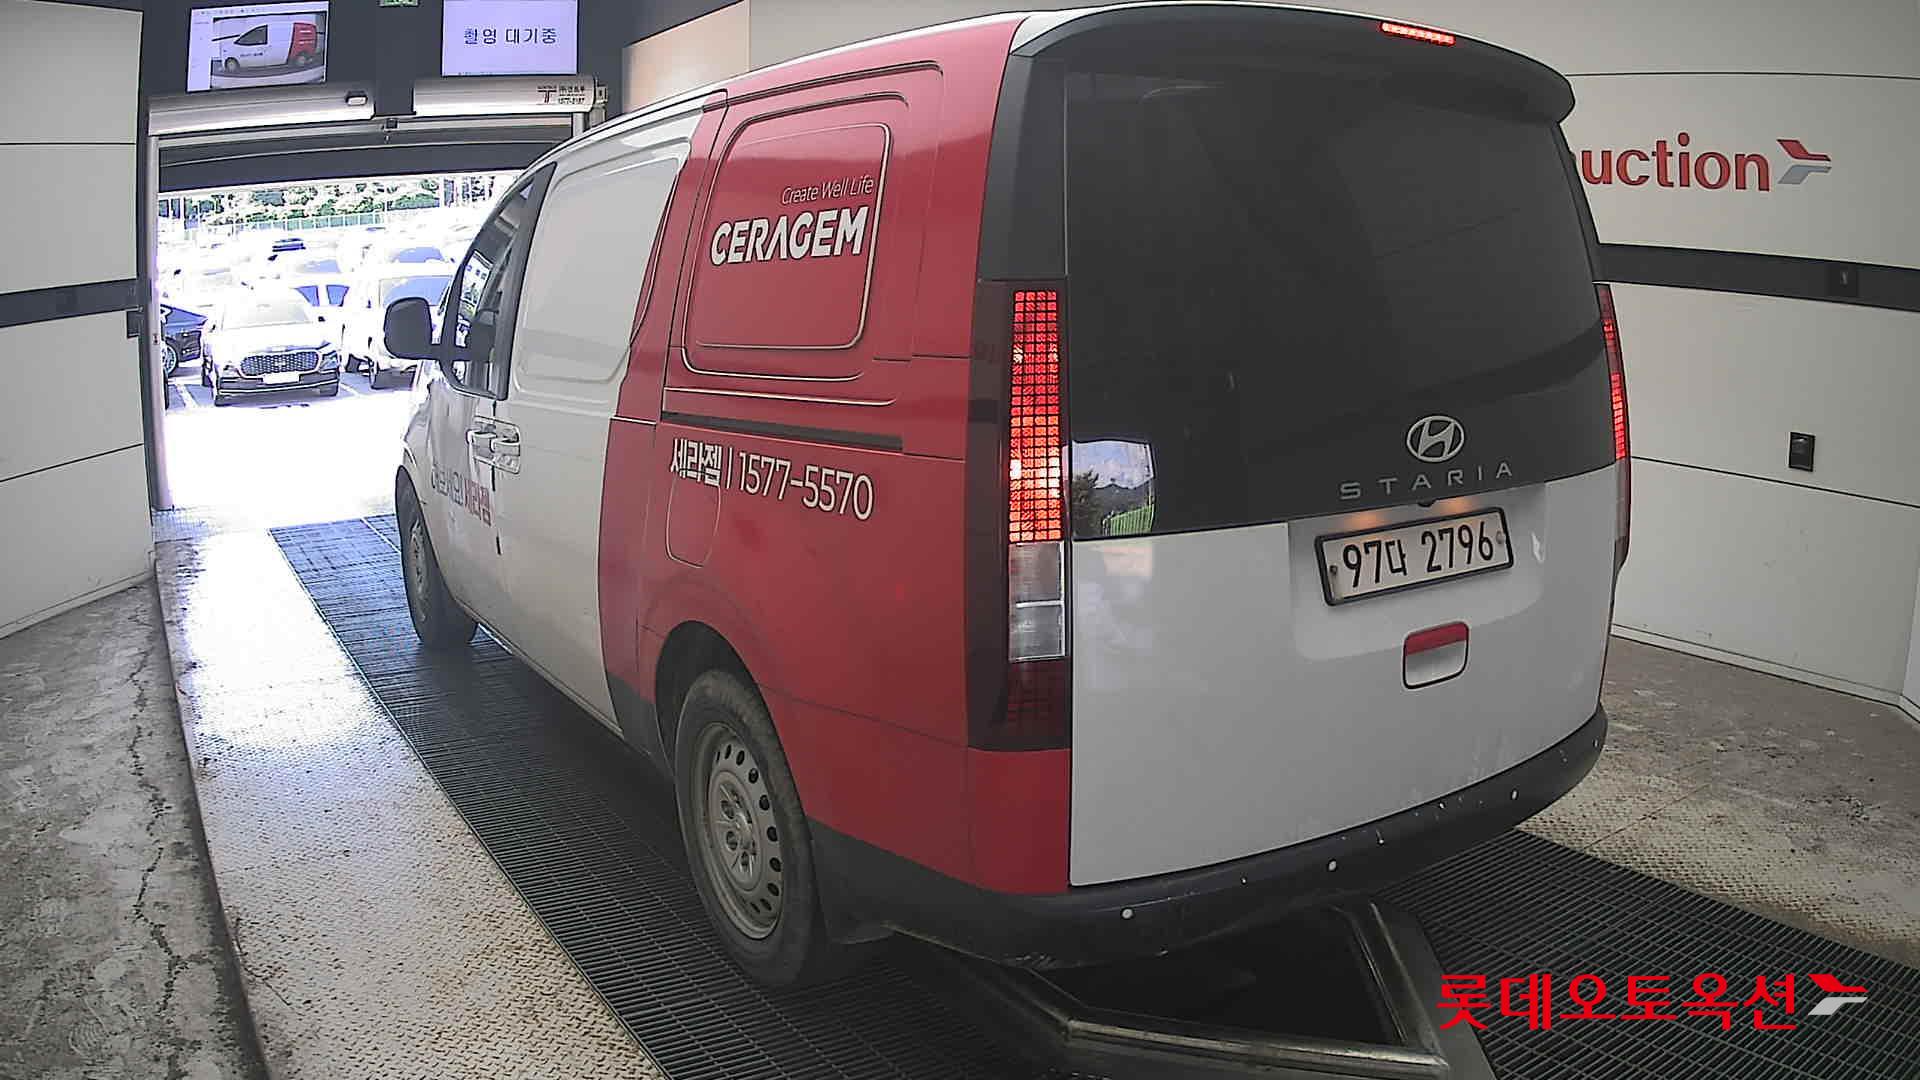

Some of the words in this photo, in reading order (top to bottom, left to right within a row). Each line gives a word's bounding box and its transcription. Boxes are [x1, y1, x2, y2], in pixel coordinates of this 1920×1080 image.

[505, 28, 557, 44] 대기중
[1581, 132, 1770, 192] uction
[782, 184, 818, 205] Create
[821, 178, 849, 199] Well
[850, 174, 874, 195] Life
[711, 206, 869, 266] CERAGEM
[670, 438, 722, 488] 세라젬
[739, 452, 875, 520] 1577-5570
[1340, 462, 1513, 500] STARIA
[1421, 521, 1494, 574] 2796
